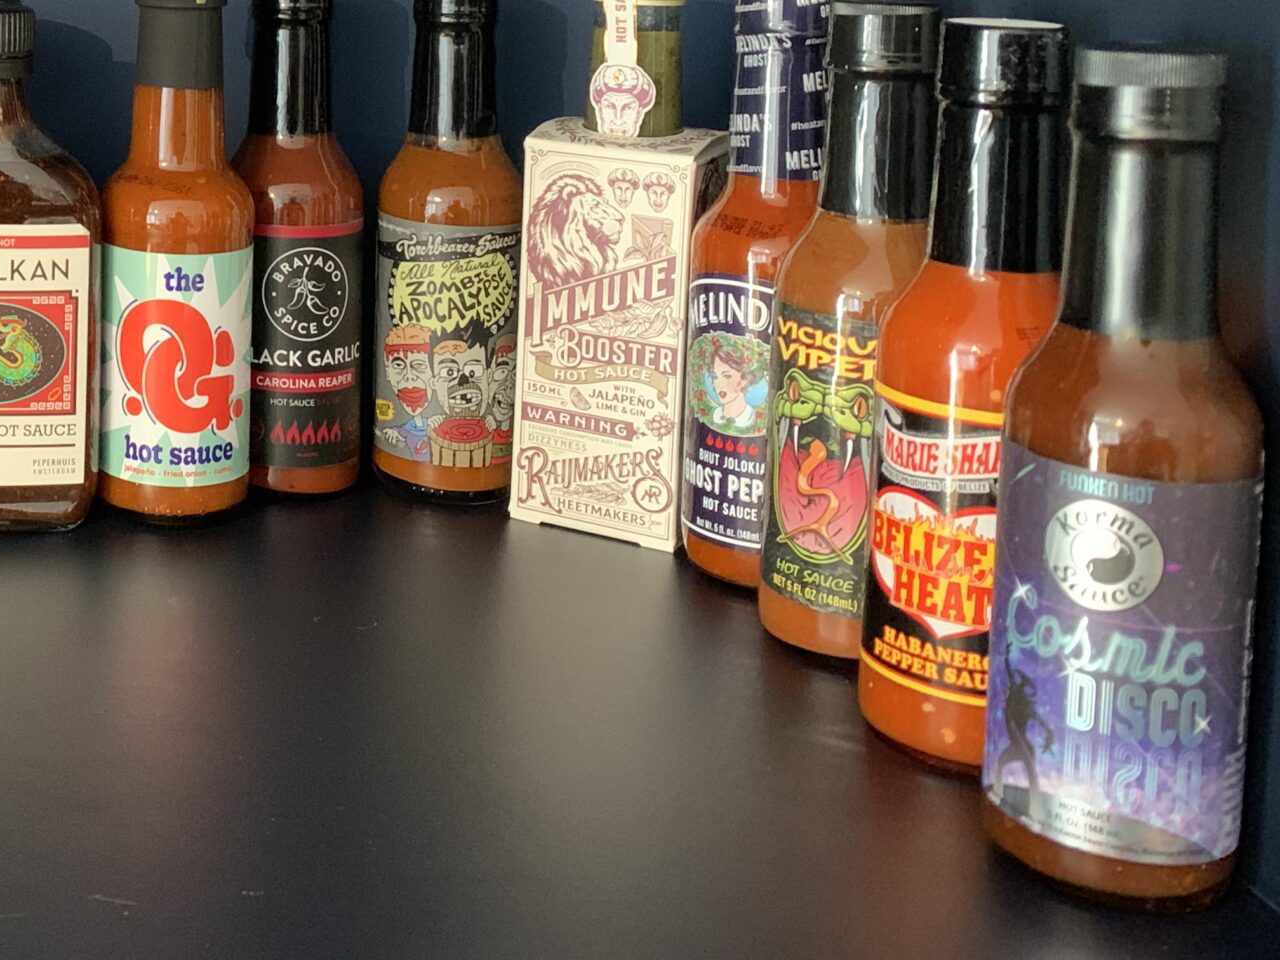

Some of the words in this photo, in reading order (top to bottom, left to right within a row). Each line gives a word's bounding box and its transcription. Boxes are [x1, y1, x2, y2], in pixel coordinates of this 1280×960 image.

[615, 17, 628, 43] HOT
[395, 233, 477, 260] Torchbearer
[475, 233, 517, 257] Sauces
[163, 266, 206, 293] the
[271, 253, 343, 284] BRAVADO
[400, 263, 435, 281] All
[441, 253, 502, 280] Natural
[398, 265, 507, 324] APOCALYPSE
[405, 269, 491, 298] ZOMBIE
[482, 280, 513, 323] SAUCE
[531, 260, 669, 347] IMMUNE
[690, 291, 773, 333] MELIND
[273, 306, 319, 335] SPICE
[322, 305, 340, 327] CO
[556, 325, 674, 374] BOOSTER
[777, 315, 878, 357] VICIOU
[306, 341, 360, 367] GARLIC
[256, 375, 317, 389] CAROLINA
[318, 372, 353, 388] REAPER
[553, 368, 589, 382] HOT
[593, 366, 652, 382] SAUCE
[269, 398, 287, 407] HOT
[288, 398, 316, 407] SAUCE
[588, 388, 656, 410] JALAPEÑO
[613, 384, 636, 395] WITH
[526, 405, 629, 437] WARNING
[595, 401, 620, 414] LIME
[621, 406, 629, 414] &
[629, 408, 647, 418] GIN
[22, 422, 78, 438] SAUCE
[527, 433, 588, 452] DIZZYNESS
[32, 457, 77, 468] PEPERHUIS
[124, 433, 164, 465] hot
[169, 441, 234, 466] sauce
[698, 447, 721, 466] BHUT
[885, 428, 940, 475] MARIE
[163, 468, 183, 478] fried
[184, 470, 207, 478] onion
[516, 445, 674, 515] RAIJMAKERS
[684, 456, 723, 496] GHOST
[900, 475, 941, 491] PRODUCTS
[957, 481, 989, 493] BELIZE
[1059, 469, 1119, 498] FUNKEN
[1121, 483, 1155, 505] HOT
[556, 497, 647, 527] HEETMAKERS
[702, 495, 720, 513] HOT
[722, 502, 758, 522] SAUCE
[872, 510, 989, 574] BELIZE
[776, 556, 800, 578] HOT
[802, 569, 855, 594] SAUCE
[773, 571, 786, 588] NET
[785, 578, 793, 592] 5
[793, 581, 803, 597] FL
[804, 586, 817, 601] OZ
[818, 590, 859, 614] (148mL)
[892, 564, 993, 627] HEAT
[1004, 583, 1208, 687] Cosmic
[874, 637, 939, 680] PEPPER
[1065, 670, 1208, 748] DISCO
[1058, 800, 1078, 814] HOT
[1080, 806, 1113, 822] SAUCE
